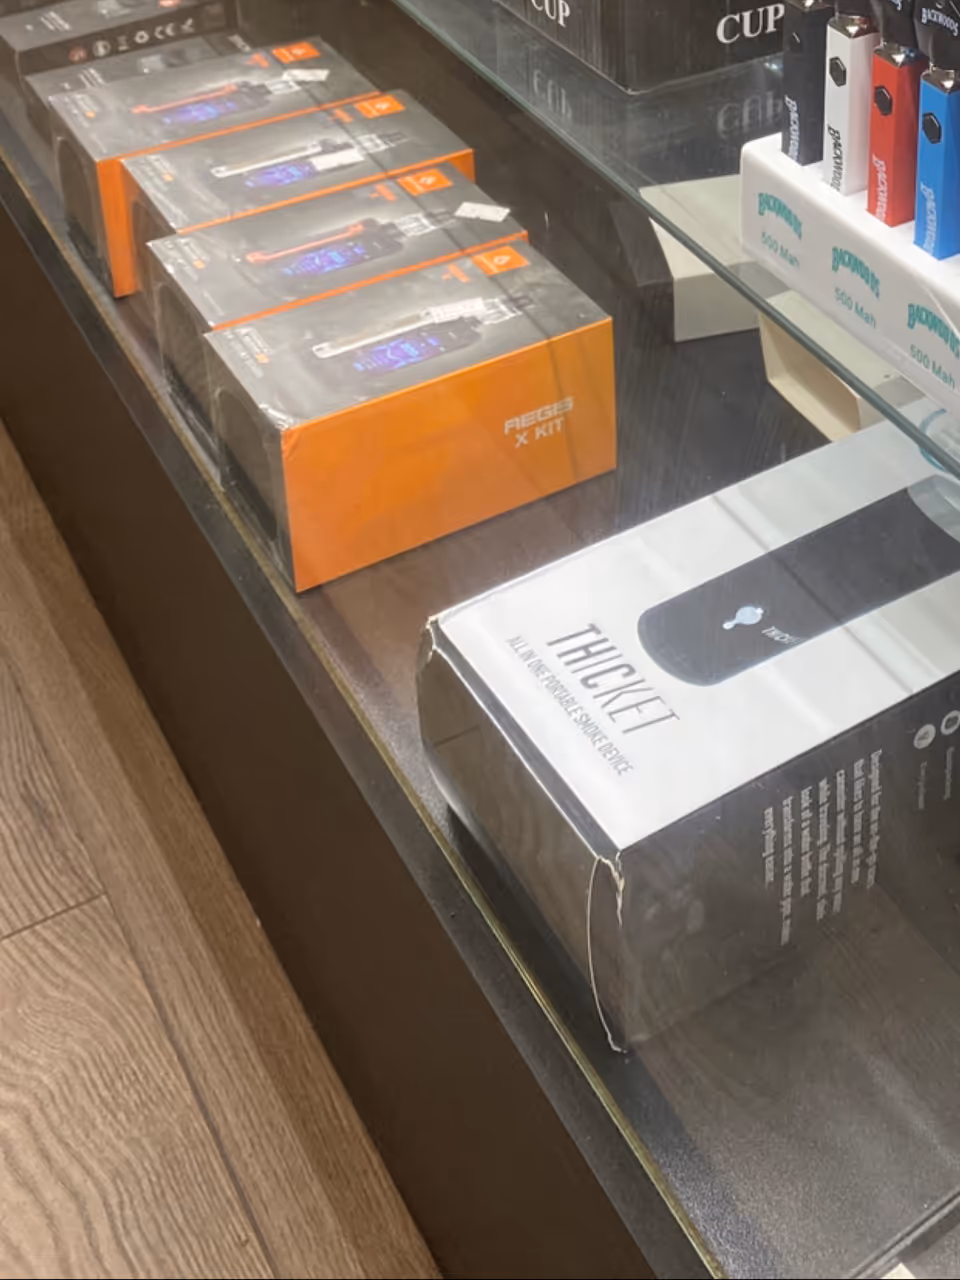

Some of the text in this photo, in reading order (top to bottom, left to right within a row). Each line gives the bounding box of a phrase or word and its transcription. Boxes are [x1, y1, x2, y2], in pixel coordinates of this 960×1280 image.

[716, 2, 786, 46] CUP
[922, 7, 959, 37] BACKWOODS
[758, 192, 802, 241] BACKWOODS
[832, 246, 881, 300] BACKWOODS
[834, 287, 877, 330] 500 Mah
[908, 303, 960, 360] BACKWOODS
[910, 344, 956, 391] 500 Mah
[504, 397, 574, 434] AEGIS
[515, 417, 564, 448] X KIT
[546, 623, 681, 735] THICKET
[506, 635, 634, 776] ALL IN ONE PORTABLE SMOKE DEVICE
